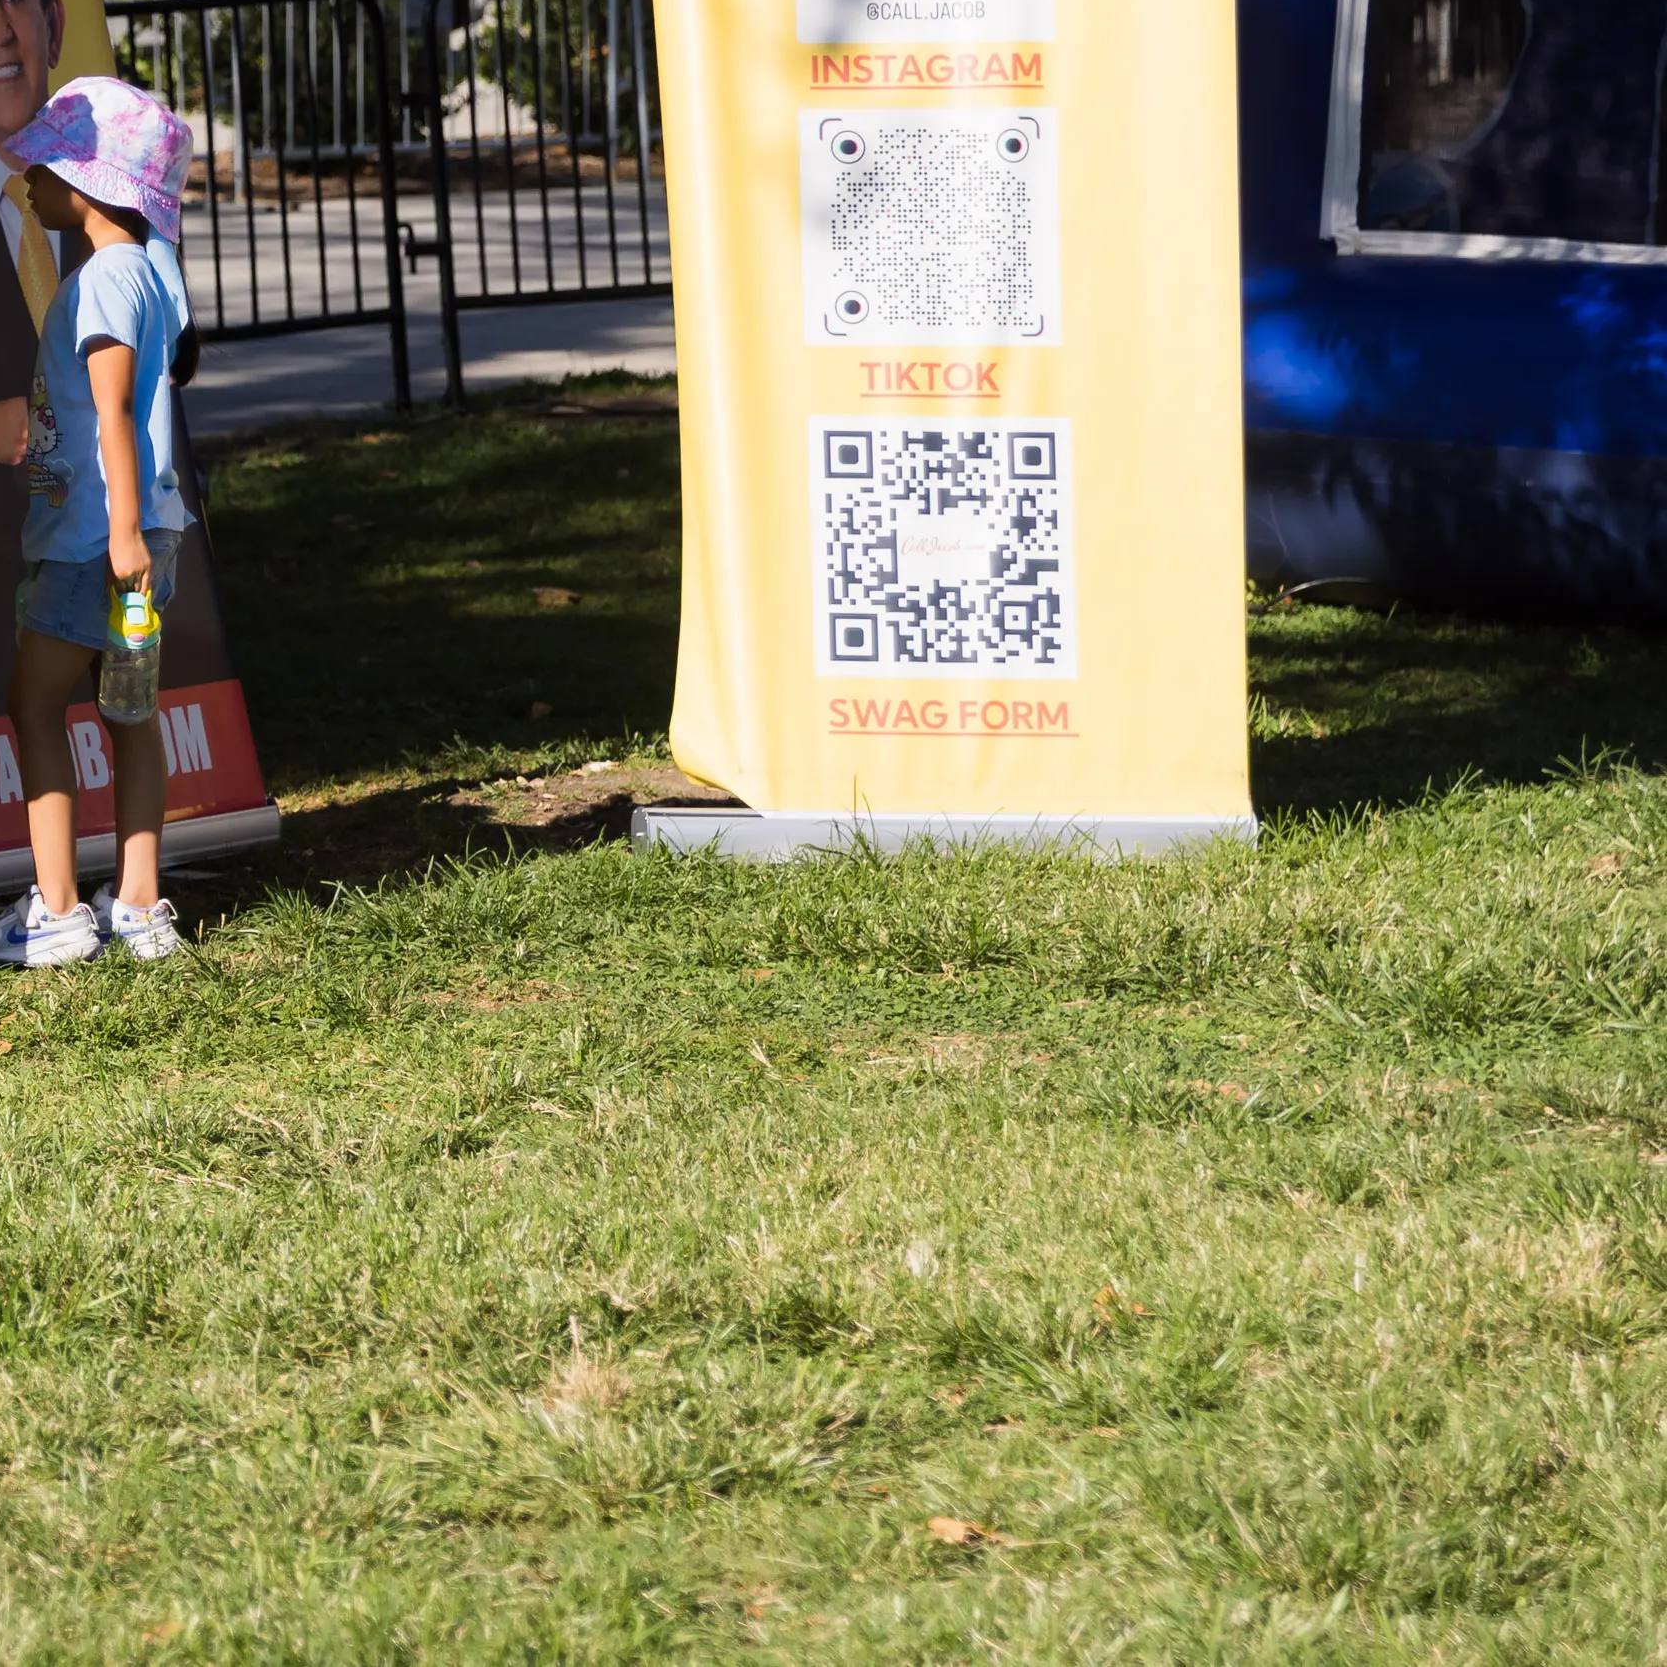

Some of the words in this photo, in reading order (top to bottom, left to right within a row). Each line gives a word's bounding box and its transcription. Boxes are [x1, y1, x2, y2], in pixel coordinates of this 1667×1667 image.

[866, 0, 986, 22] @CALL.JACOB
[811, 53, 1044, 85] INSTAGRAM
[860, 361, 1000, 393] TIKTOK
[828, 699, 945, 731] SWAG
[959, 698, 1070, 730] FORM
